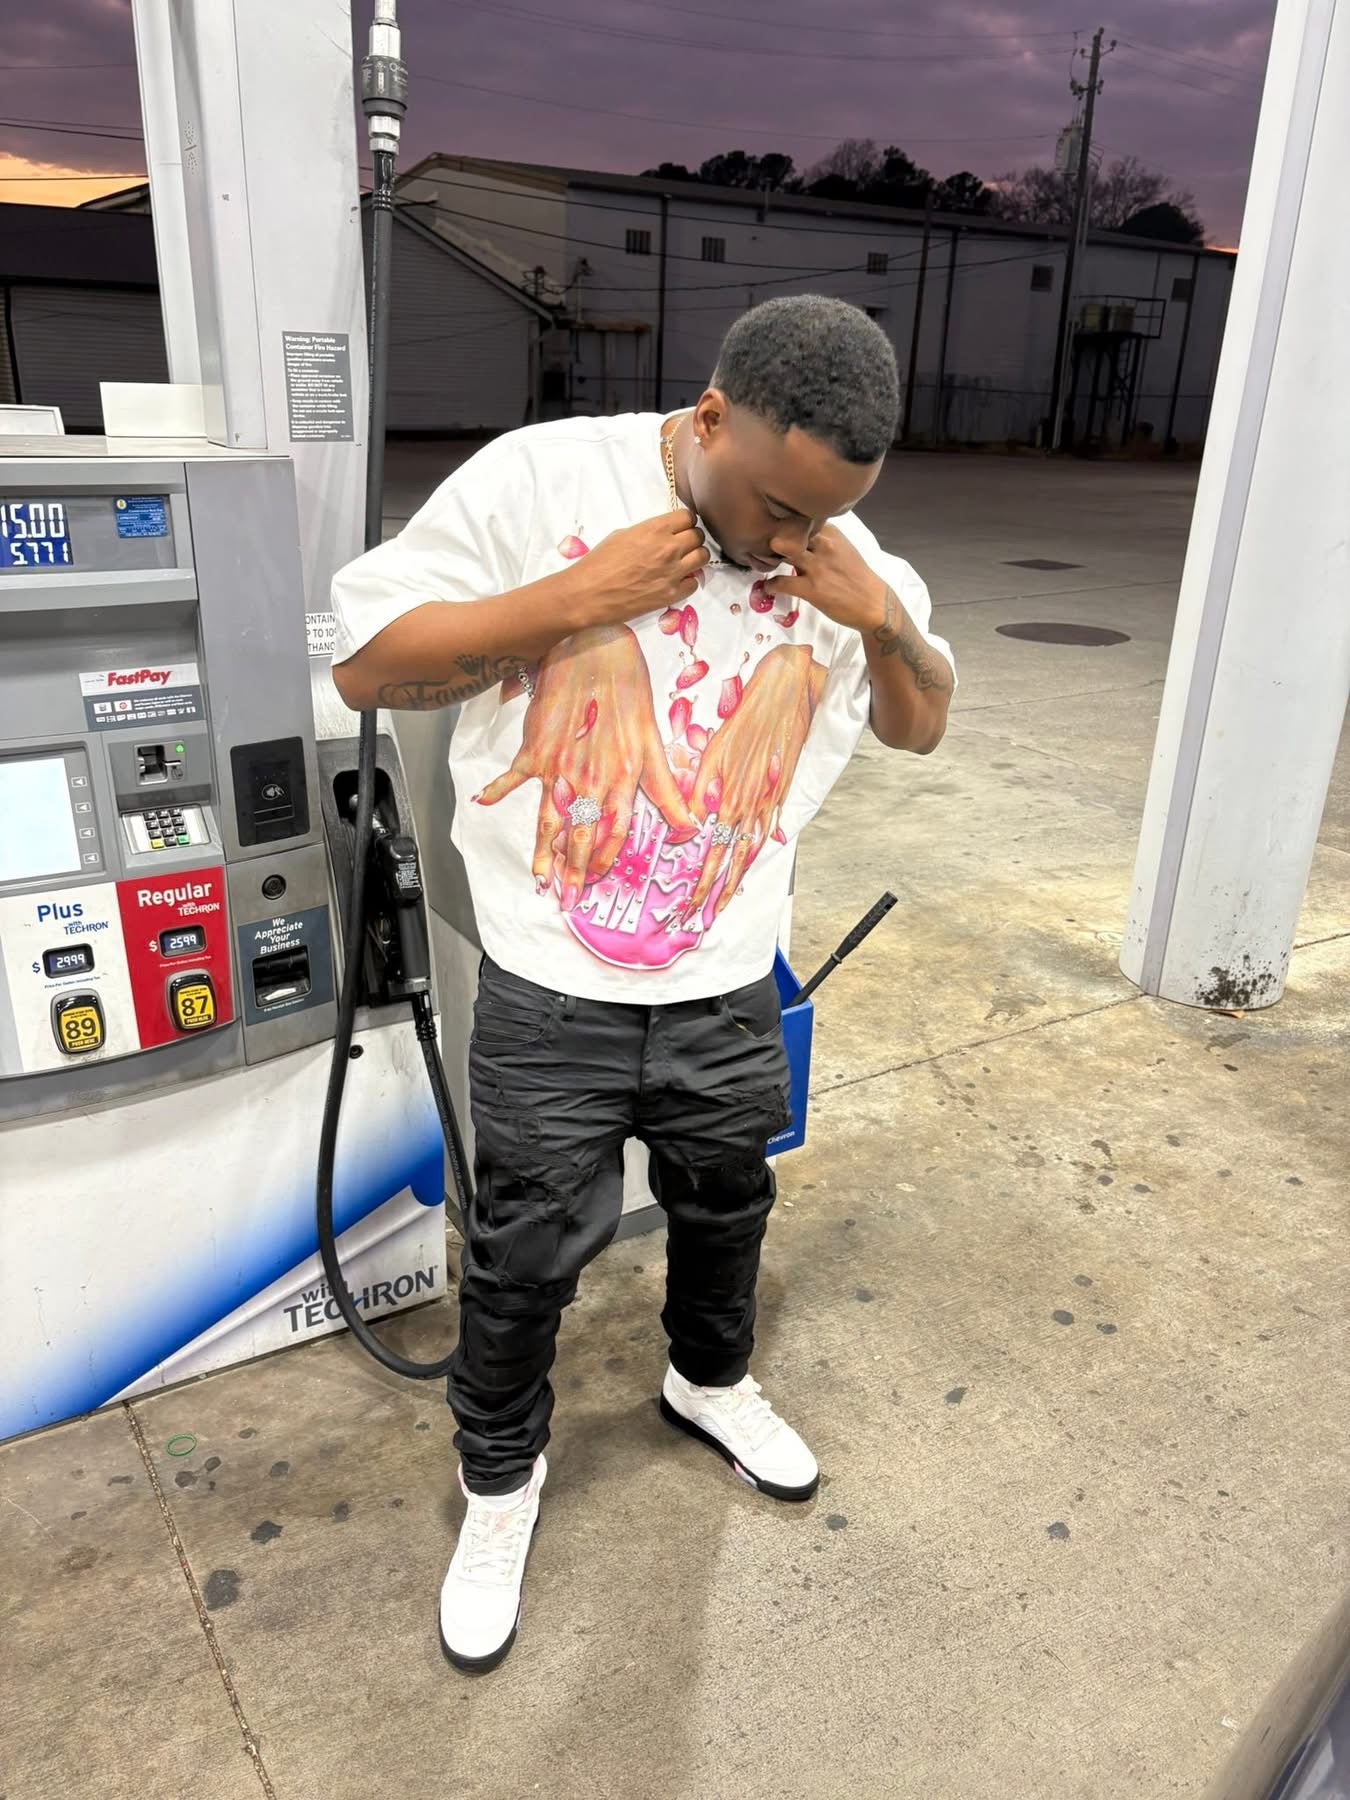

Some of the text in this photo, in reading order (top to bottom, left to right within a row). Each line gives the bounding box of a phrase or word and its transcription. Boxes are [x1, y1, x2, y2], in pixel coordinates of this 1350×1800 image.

[312, 336, 336, 344] Portable
[314, 343, 326, 351] Fire
[312, 628, 324, 638] TO
[108, 669, 173, 687] FastPay
[137, 882, 213, 908] Regular
[37, 902, 84, 923] Plus
[178, 902, 220, 917] TECHRON
[64, 920, 110, 936] TECHRON
[254, 921, 304, 940] Appreciate
[272, 918, 286, 928] We
[148, 940, 158, 952] $
[270, 932, 291, 945] Your
[260, 938, 301, 955] Business
[32, 961, 41, 974] $
[181, 995, 209, 1017] 87
[65, 1017, 97, 1040] 89
